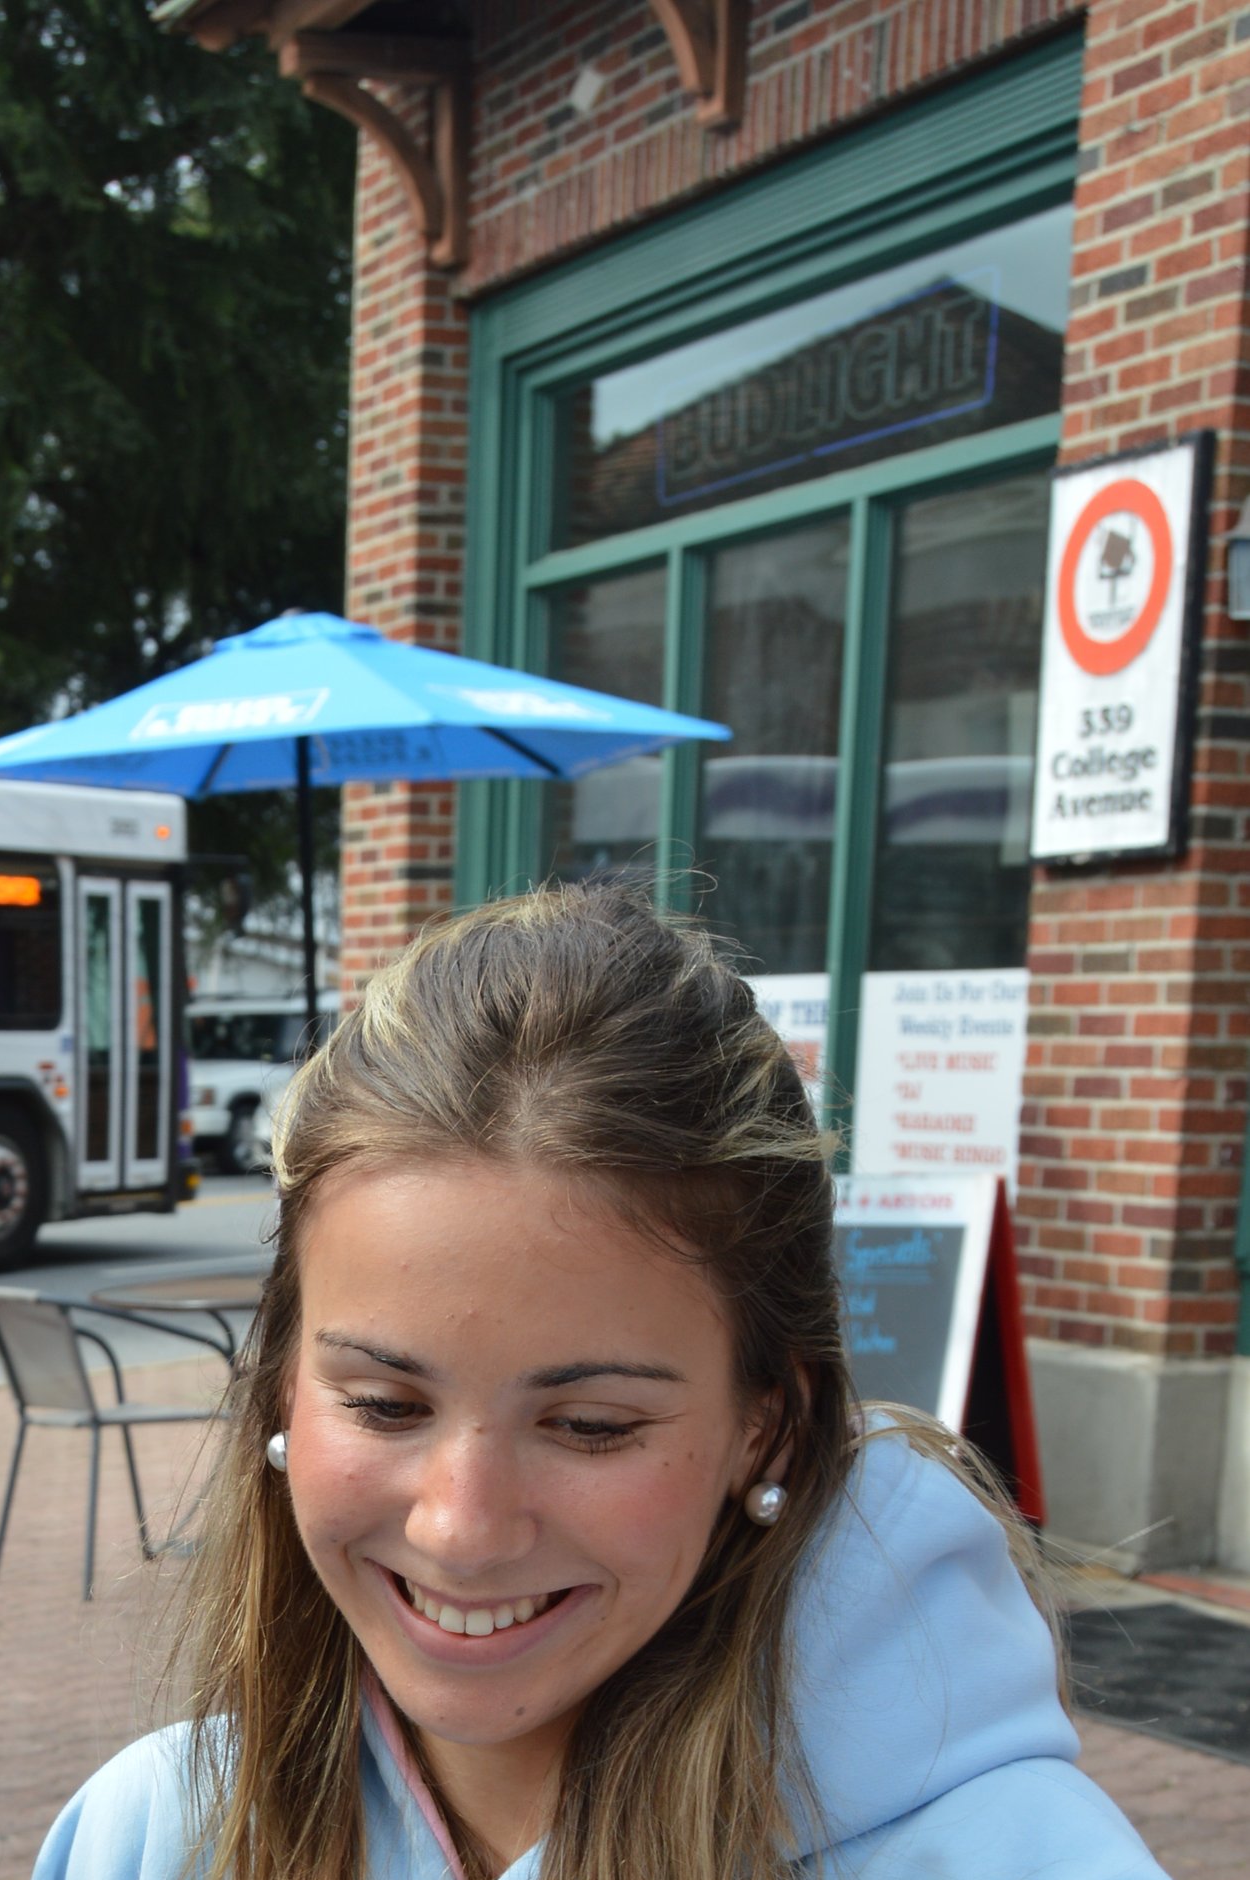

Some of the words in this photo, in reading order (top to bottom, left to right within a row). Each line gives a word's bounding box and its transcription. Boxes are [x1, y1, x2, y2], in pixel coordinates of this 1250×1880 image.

[1051, 746, 1157, 781] College
[1050, 790, 1152, 819] Avenue
[894, 979, 928, 1003] Join
[959, 979, 985, 1003] For
[899, 1014, 952, 1041] Weekly
[960, 1014, 1013, 1036] Events
[945, 1053, 996, 1071] MUSIC
[952, 1145, 1007, 1166] BINGO
